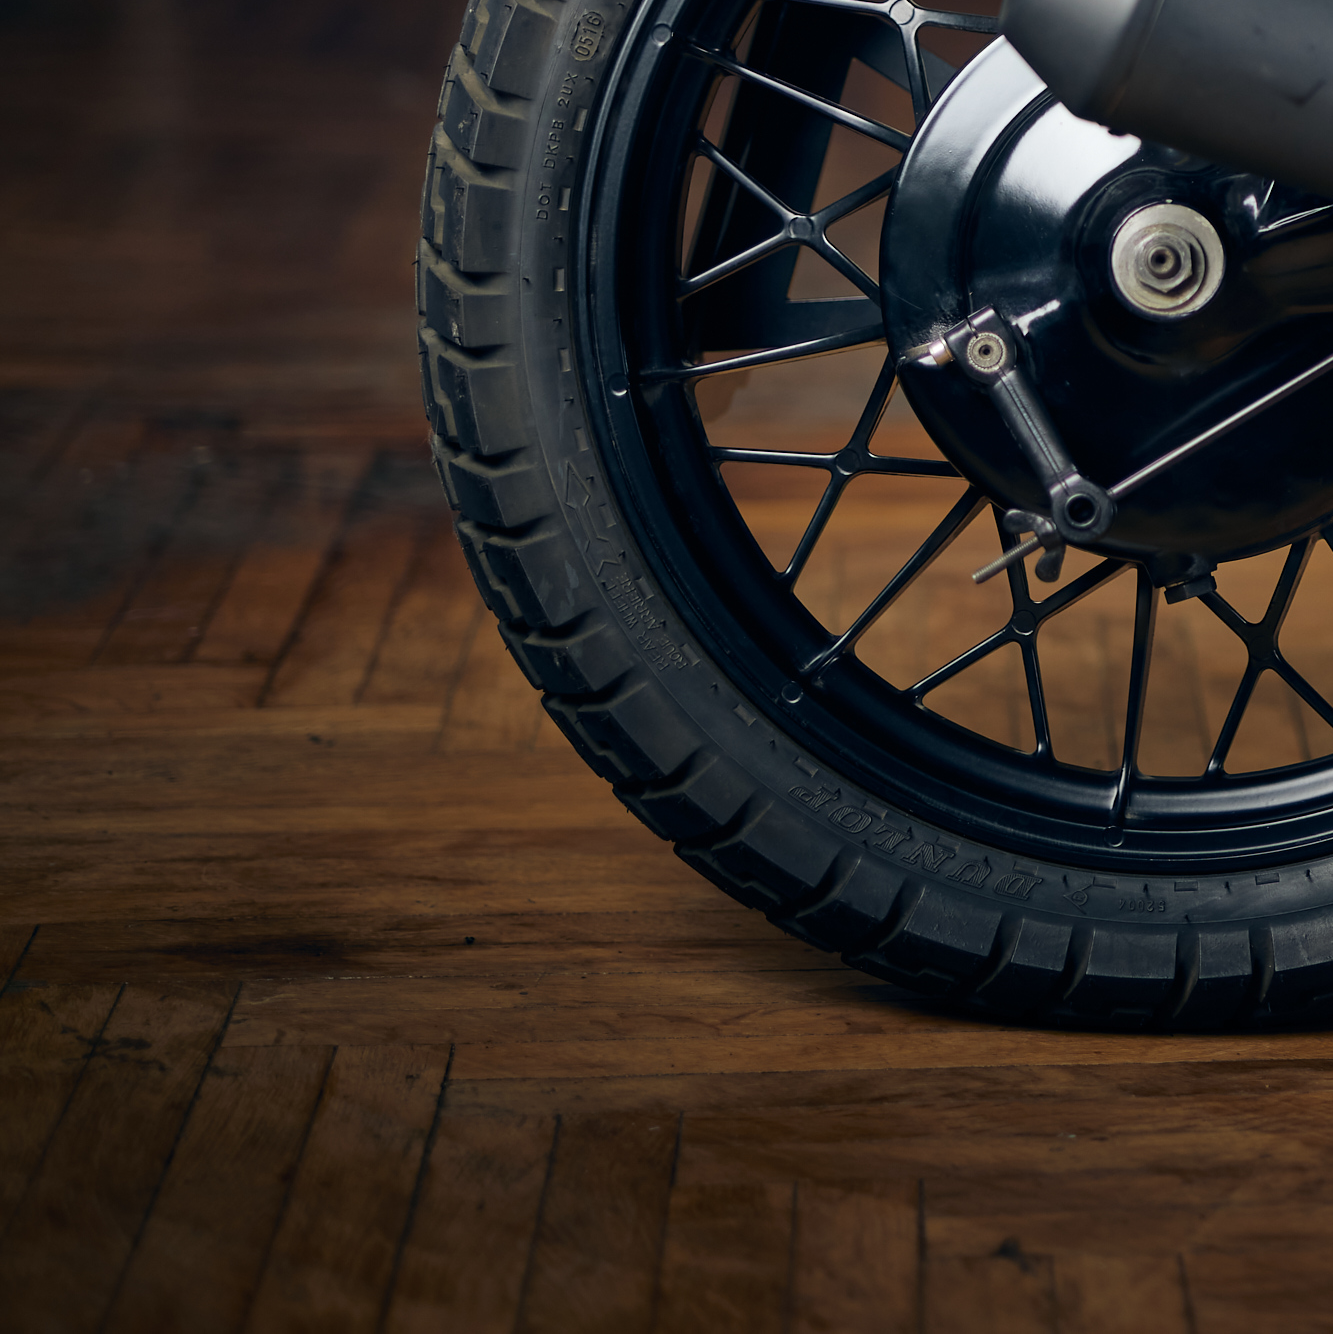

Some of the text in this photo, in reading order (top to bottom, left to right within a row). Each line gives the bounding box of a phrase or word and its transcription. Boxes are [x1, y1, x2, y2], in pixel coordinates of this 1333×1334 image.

[535, 15, 602, 221] DOT DKPB 2UX 0516
[600, 575, 670, 672] REAR WHEEL
[615, 570, 688, 671] ROUE ARRIERE
[786, 782, 1042, 902] DUNLOP
